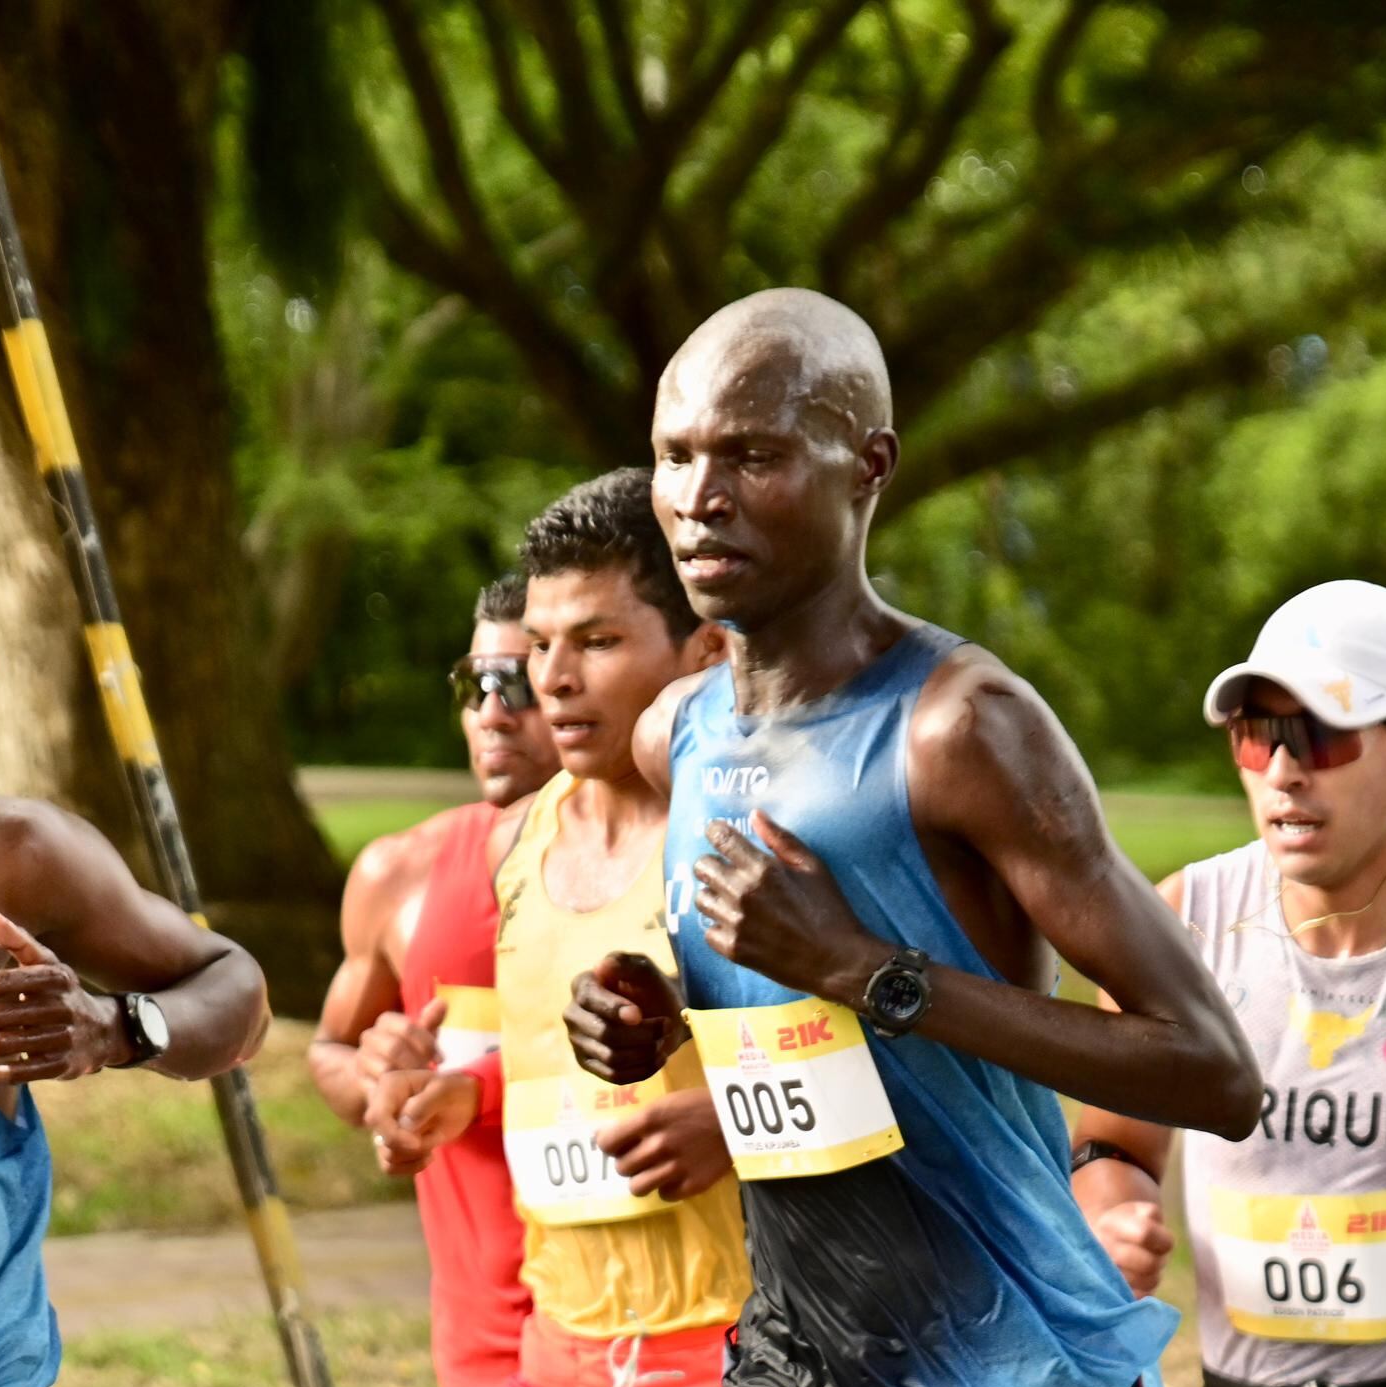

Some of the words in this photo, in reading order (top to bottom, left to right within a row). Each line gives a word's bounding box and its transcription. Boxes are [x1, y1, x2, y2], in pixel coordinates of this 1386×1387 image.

[777, 1016, 834, 1051] 21K
[594, 1085, 640, 1110] 21K
[725, 1079, 816, 1136] 005
[1264, 1256, 1365, 1304] 006
